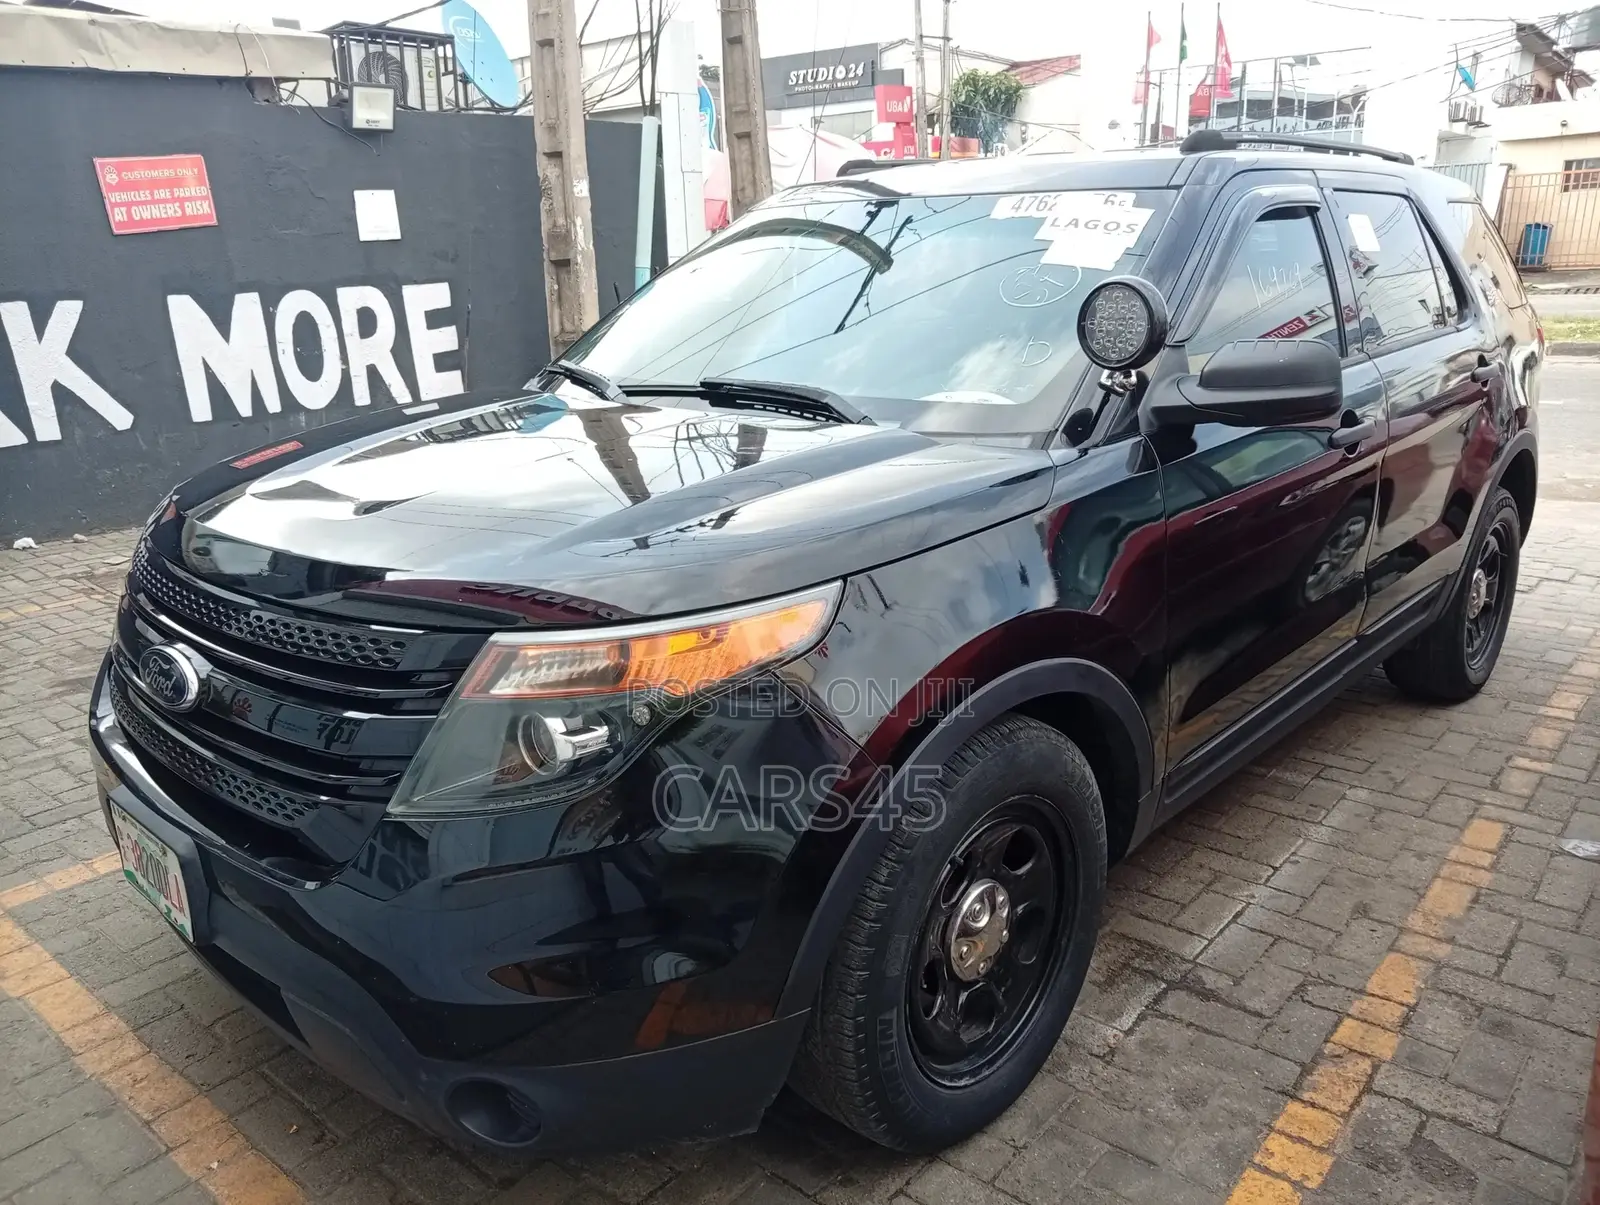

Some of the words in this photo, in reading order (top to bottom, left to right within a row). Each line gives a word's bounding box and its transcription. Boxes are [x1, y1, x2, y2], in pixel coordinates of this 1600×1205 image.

[788, 64, 847, 86] STUDIO
[848, 61, 866, 79] 24
[886, 100, 903, 113] UBA
[121, 168, 176, 180] CUSTOMERS
[176, 166, 199, 176] ONLY
[108, 190, 152, 203] VEHICLES
[153, 188, 172, 201] ARE
[173, 186, 208, 198] PARKED
[114, 206, 128, 222] AT
[131, 203, 183, 221] OWNERS
[184, 200, 212, 216] RISK
[1049, 217, 1139, 234] LAGOS
[0, 299, 134, 448] K
[166, 281, 466, 423] MORE
[144, 655, 177, 697] Ford
